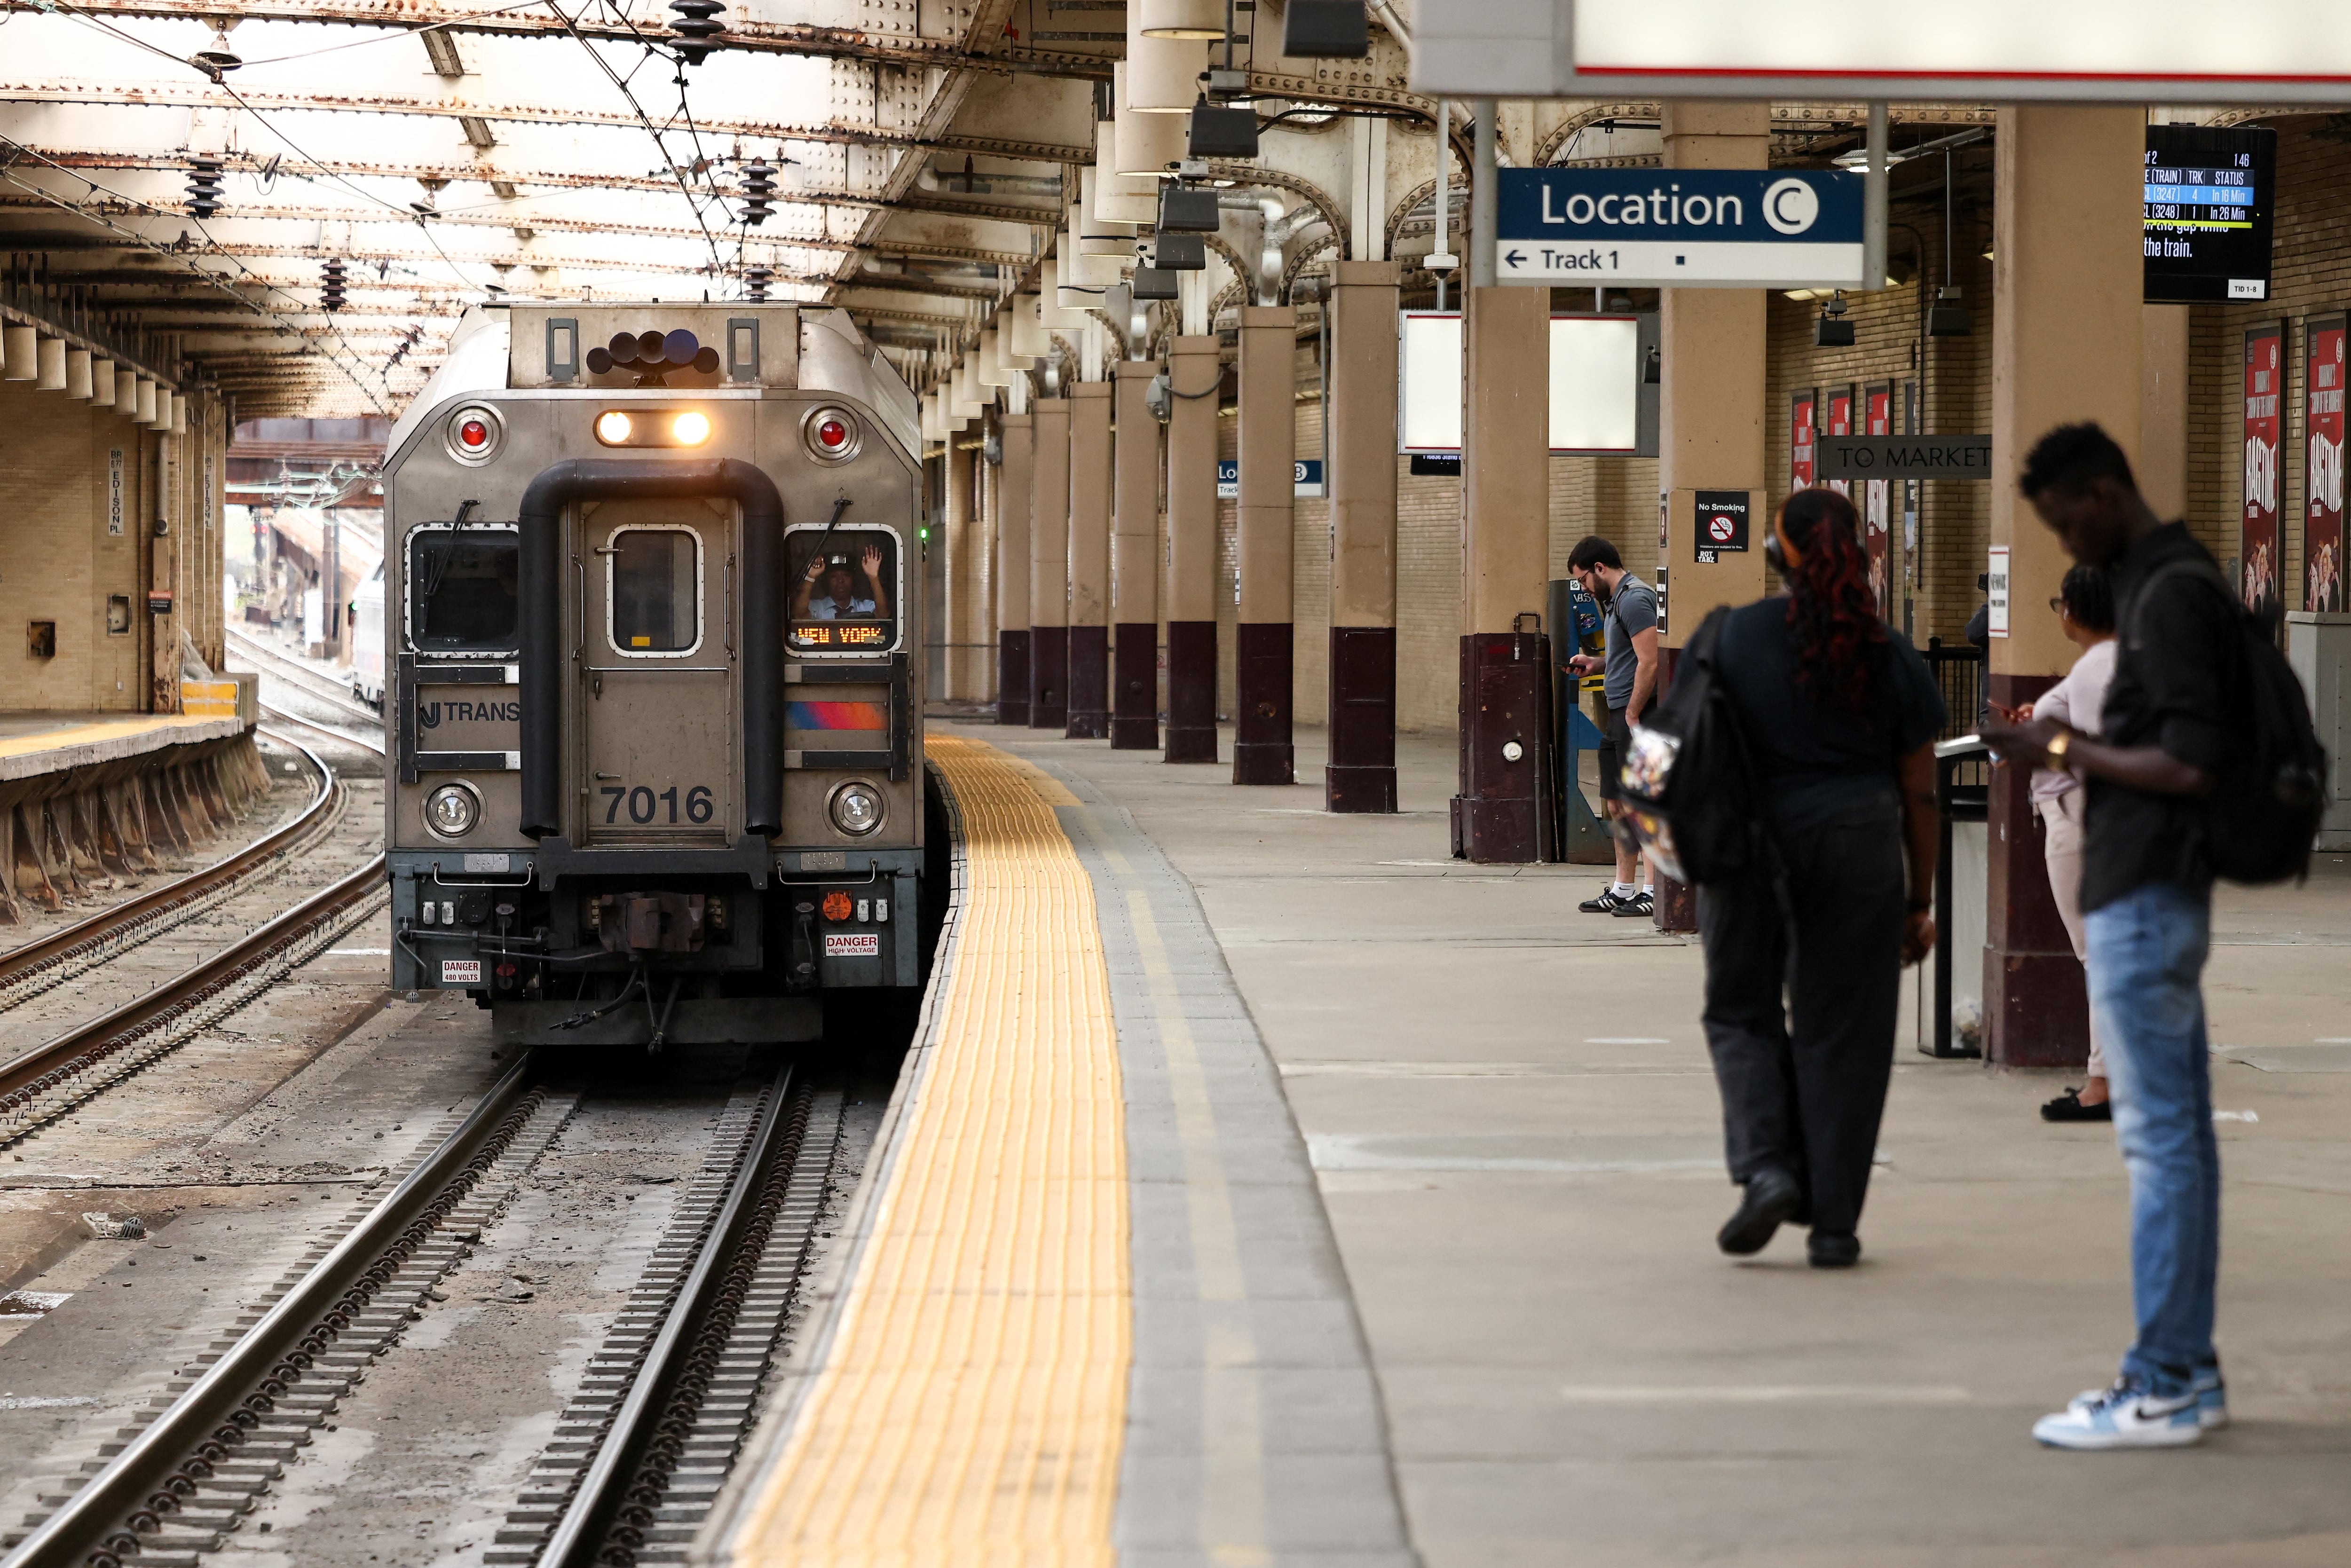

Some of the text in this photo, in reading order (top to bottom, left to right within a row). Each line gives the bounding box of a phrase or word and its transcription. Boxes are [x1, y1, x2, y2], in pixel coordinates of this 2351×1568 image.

[2152, 151, 2157, 165] 2
[2152, 168, 2182, 184] (TRAIN)
[2188, 171, 2203, 185] TRK
[2215, 171, 2244, 185] STATUS
[2154, 186, 2180, 202] (3247)
[2192, 189, 2198, 202] 4
[2212, 189, 2245, 203] In 16 Min
[1542, 183, 1802, 226] Location C
[2153, 204, 2179, 220] (3248)
[2193, 205, 2196, 220] 1
[2210, 206, 2245, 221] In 26 Min
[2144, 237, 2193, 258] the train.
[1541, 249, 1619, 270] Track 1
[111, 451, 122, 459] BR
[1837, 447, 1875, 468] TO
[1886, 447, 1991, 467] MARKET
[2246, 435, 2276, 514] RAGTIME
[2309, 432, 2343, 513] RAGTIME
[1711, 504, 1745, 512] Smoking
[110, 525, 123, 534] PL.
[798, 628, 881, 643] NEW YORK
[444, 702, 520, 722] TRANS
[600, 786, 714, 824] 7016
[827, 937, 877, 946] DANGER
[444, 962, 478, 971] DANGER
